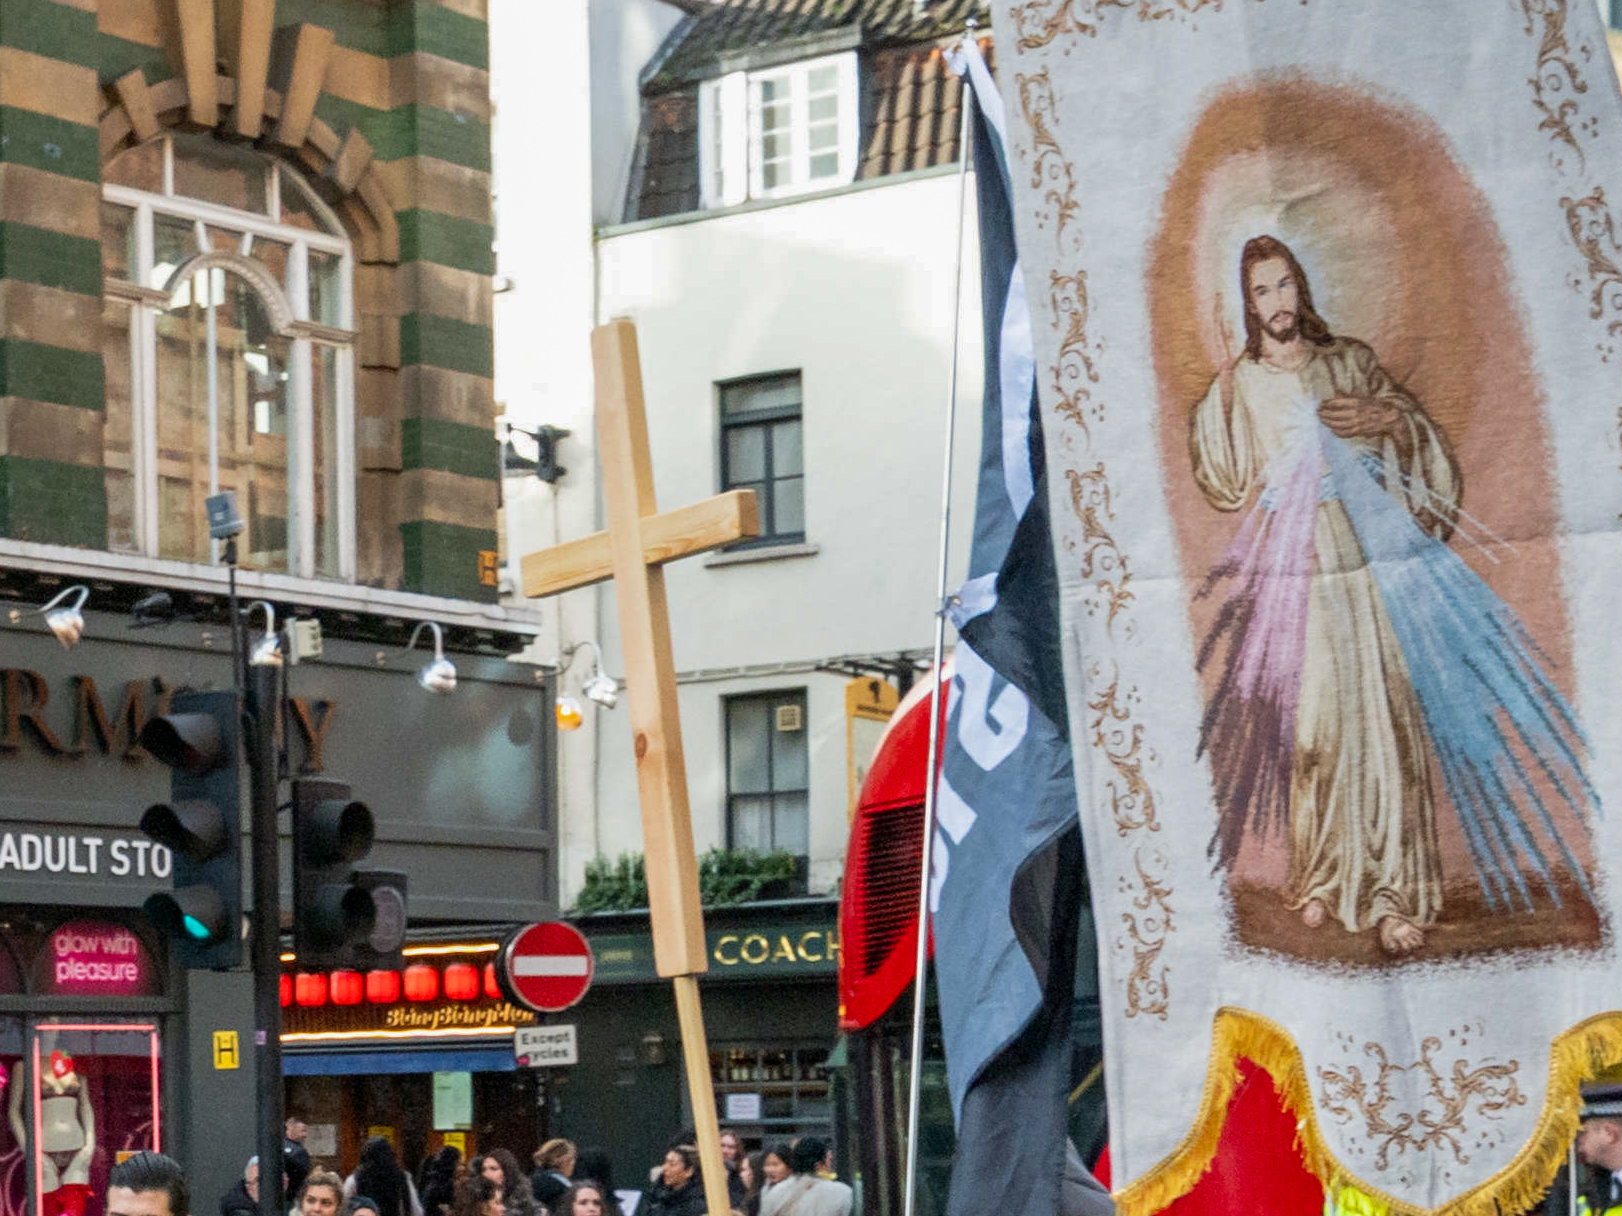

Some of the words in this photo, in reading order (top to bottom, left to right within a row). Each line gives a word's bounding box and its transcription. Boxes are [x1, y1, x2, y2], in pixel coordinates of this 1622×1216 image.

[0, 667, 338, 775] RMY
[0, 832, 103, 874] ADULT
[55, 931, 98, 956] glow
[102, 932, 138, 954] with
[55, 957, 139, 983] pleasure
[520, 1030, 571, 1046] Except
[523, 1046, 570, 1063] ycles
